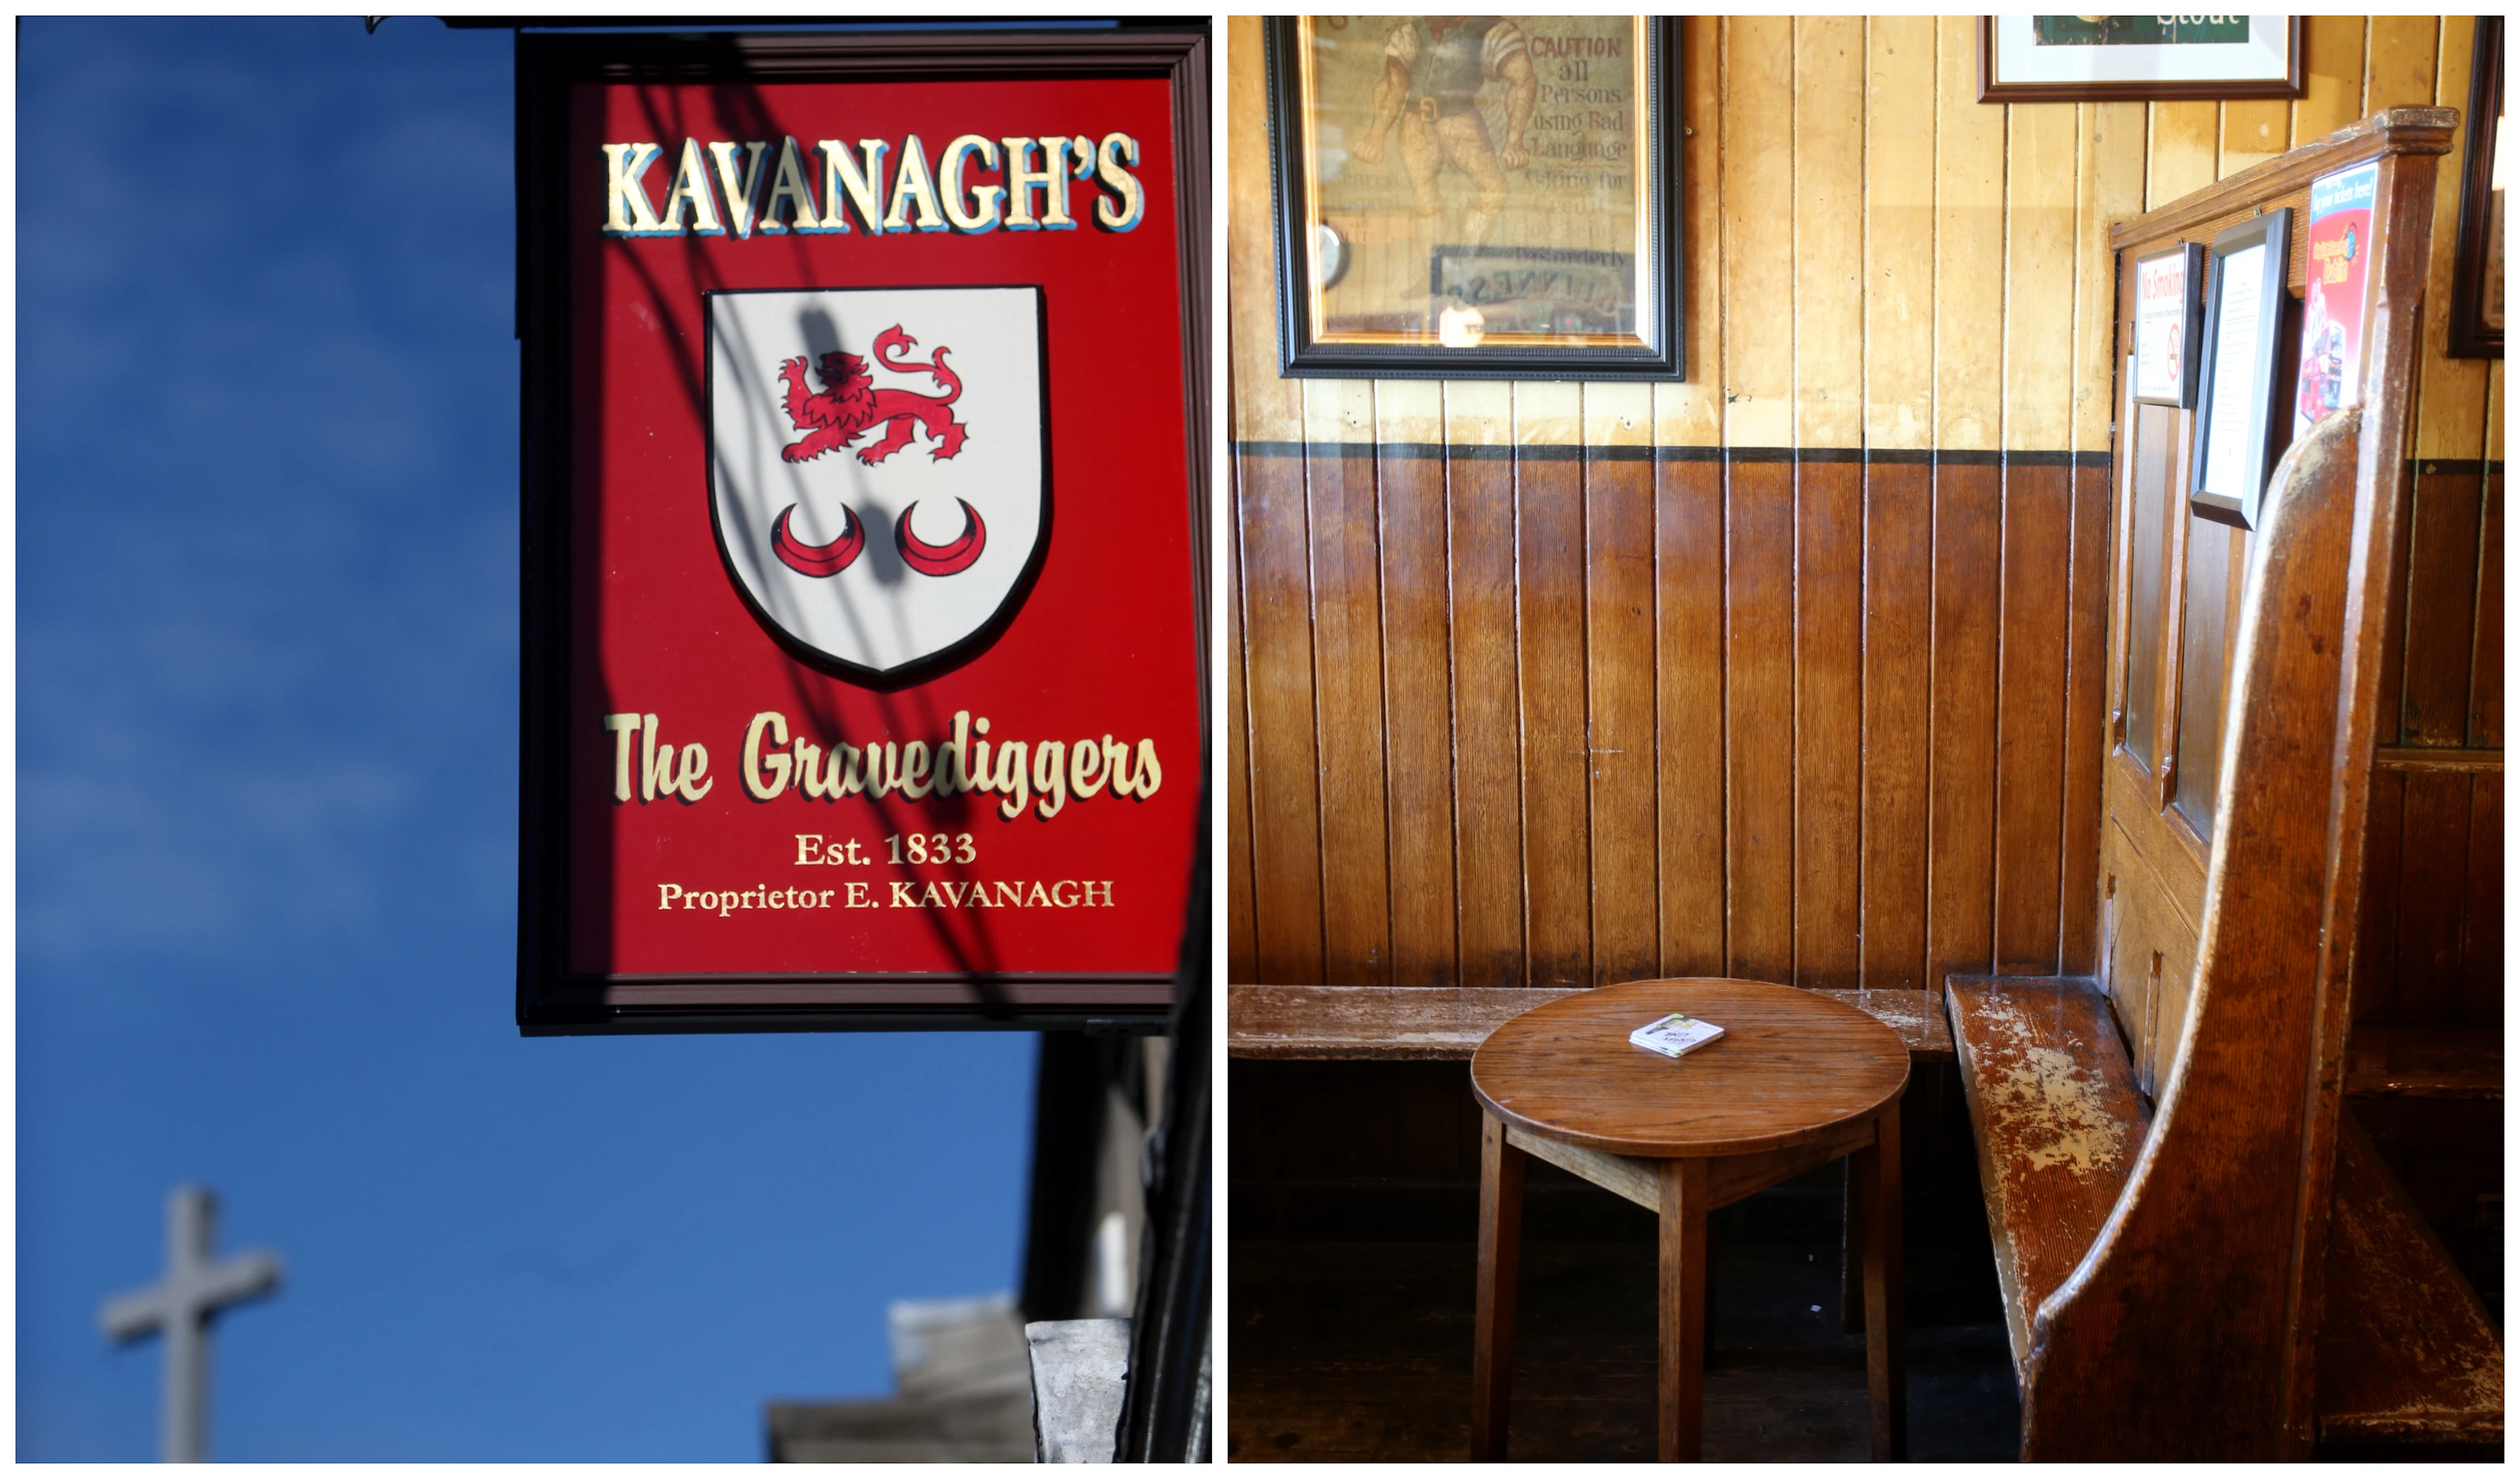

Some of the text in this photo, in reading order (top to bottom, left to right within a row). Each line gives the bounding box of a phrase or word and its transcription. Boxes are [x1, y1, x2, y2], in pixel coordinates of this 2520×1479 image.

[1531, 37, 1622, 58] CAUTION
[1559, 59, 1589, 81] all
[1542, 84, 1622, 104] Persons
[1534, 111, 1624, 136] using Bad
[1532, 137, 1628, 161] Language
[598, 132, 1144, 239] KAVANAGH'S
[1599, 171, 1628, 190] for
[2354, 177, 2374, 199] here!
[2142, 262, 2184, 304] No Smoking
[600, 710, 1162, 822] The Gravediggers
[794, 833, 976, 866] Est. 1833
[658, 880, 1115, 917] Proprietor E. KAVANAGH
